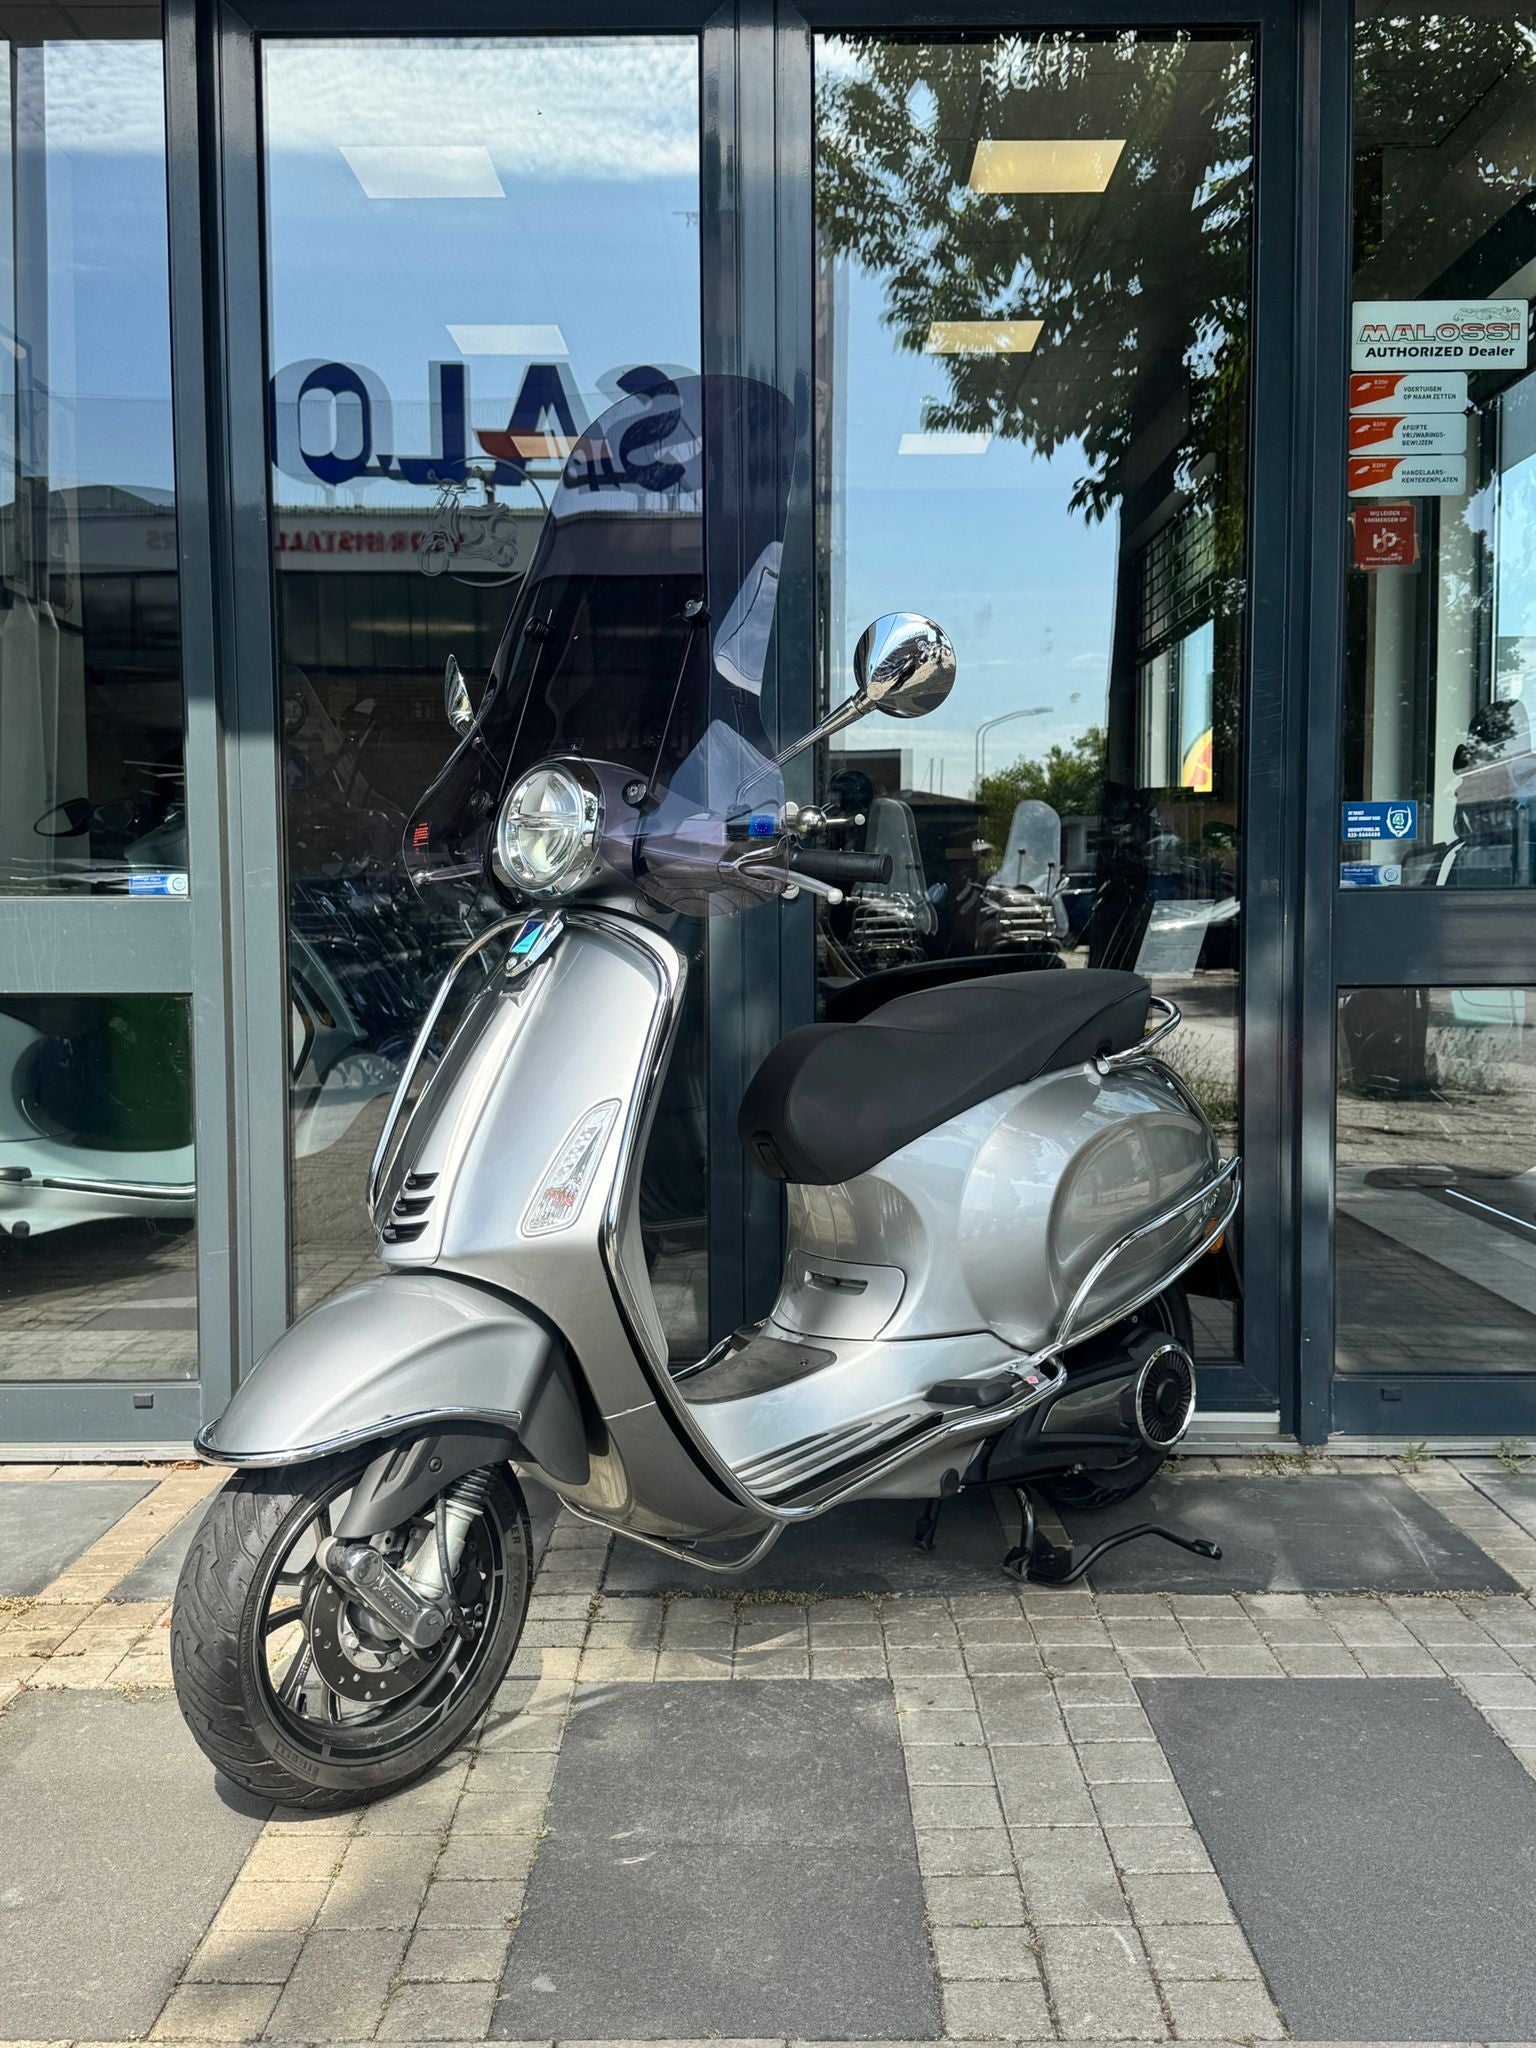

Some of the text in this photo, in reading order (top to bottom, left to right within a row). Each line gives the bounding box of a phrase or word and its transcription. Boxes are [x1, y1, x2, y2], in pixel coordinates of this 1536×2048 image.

[1356, 323, 1521, 344] MALOSSI
[1365, 346, 1516, 358] AUTHORIZED Dealer
